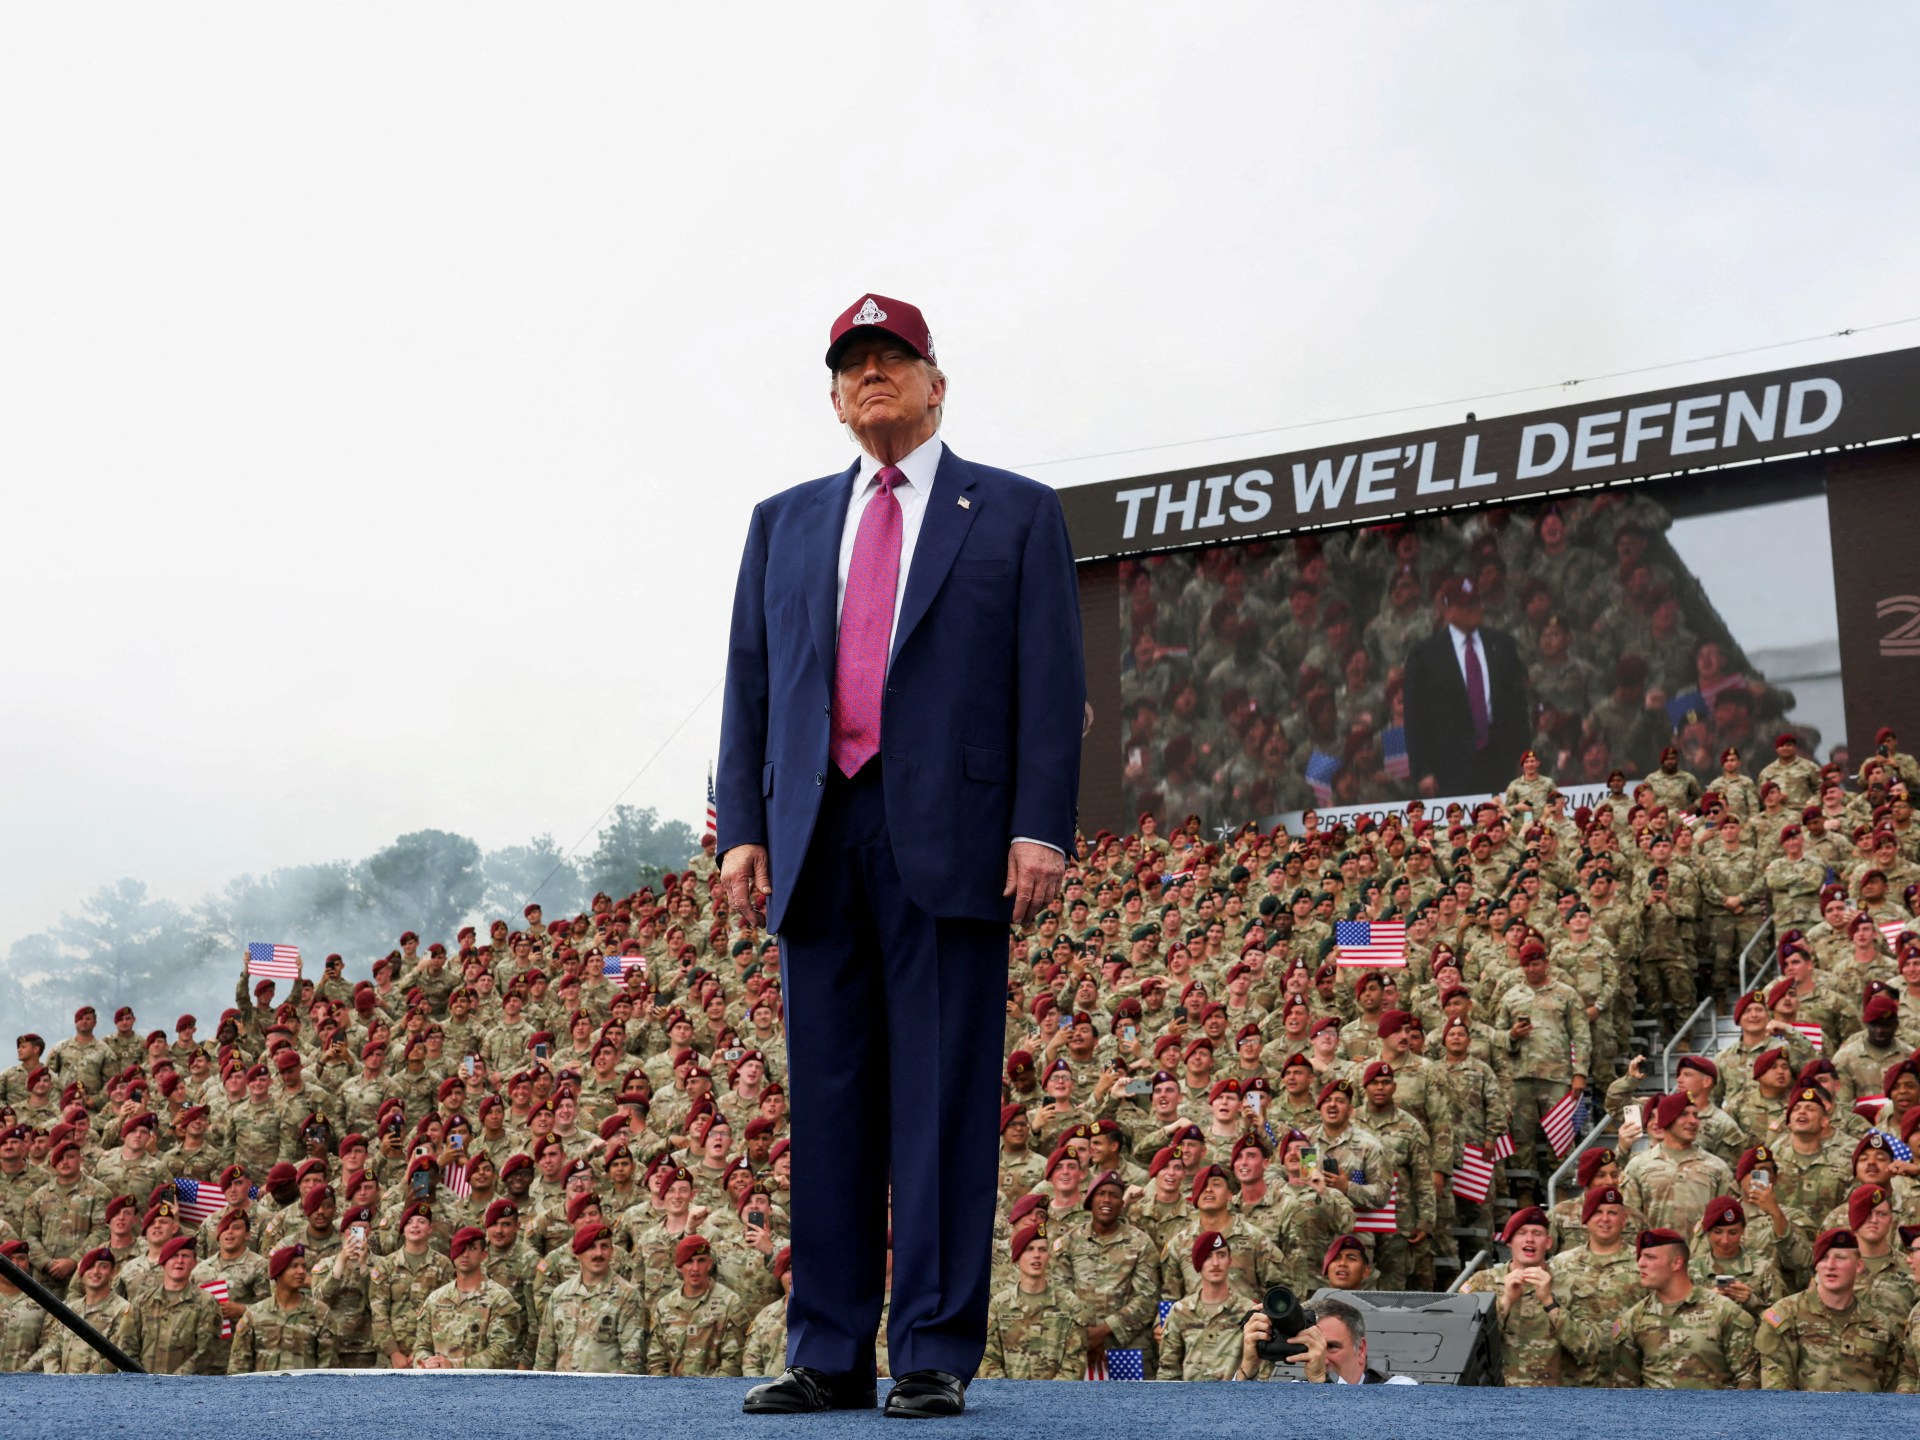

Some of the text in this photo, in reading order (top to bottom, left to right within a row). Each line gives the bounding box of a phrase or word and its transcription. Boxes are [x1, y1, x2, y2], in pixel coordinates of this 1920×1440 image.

[1116, 377, 1843, 539] THIS WE’LL DEFEND
[1563, 790, 1612, 811] RUM
[1315, 808, 1427, 832] PRESDN
